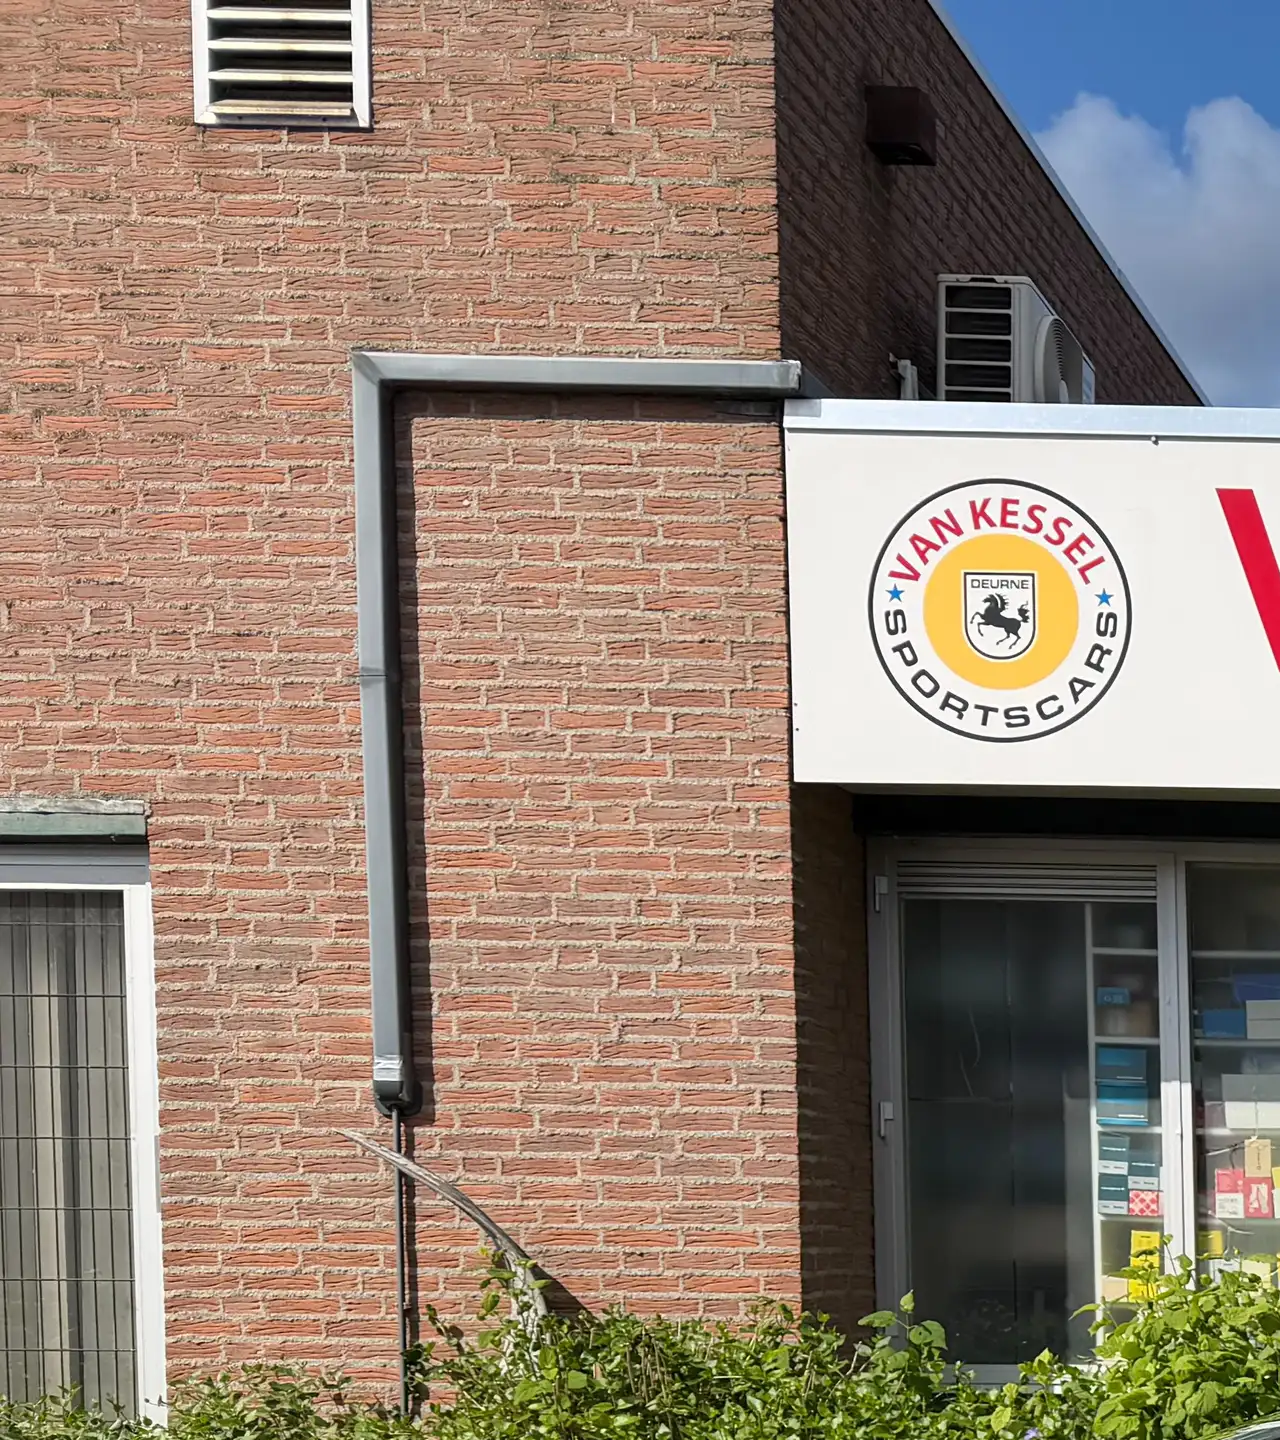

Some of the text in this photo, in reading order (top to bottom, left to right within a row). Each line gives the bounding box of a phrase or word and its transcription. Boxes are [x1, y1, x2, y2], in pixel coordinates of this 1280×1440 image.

[889, 498, 1105, 583] VAN KESSEL
[970, 578, 1030, 590] DEURNE
[884, 609, 1118, 728] SPORTSCARS
